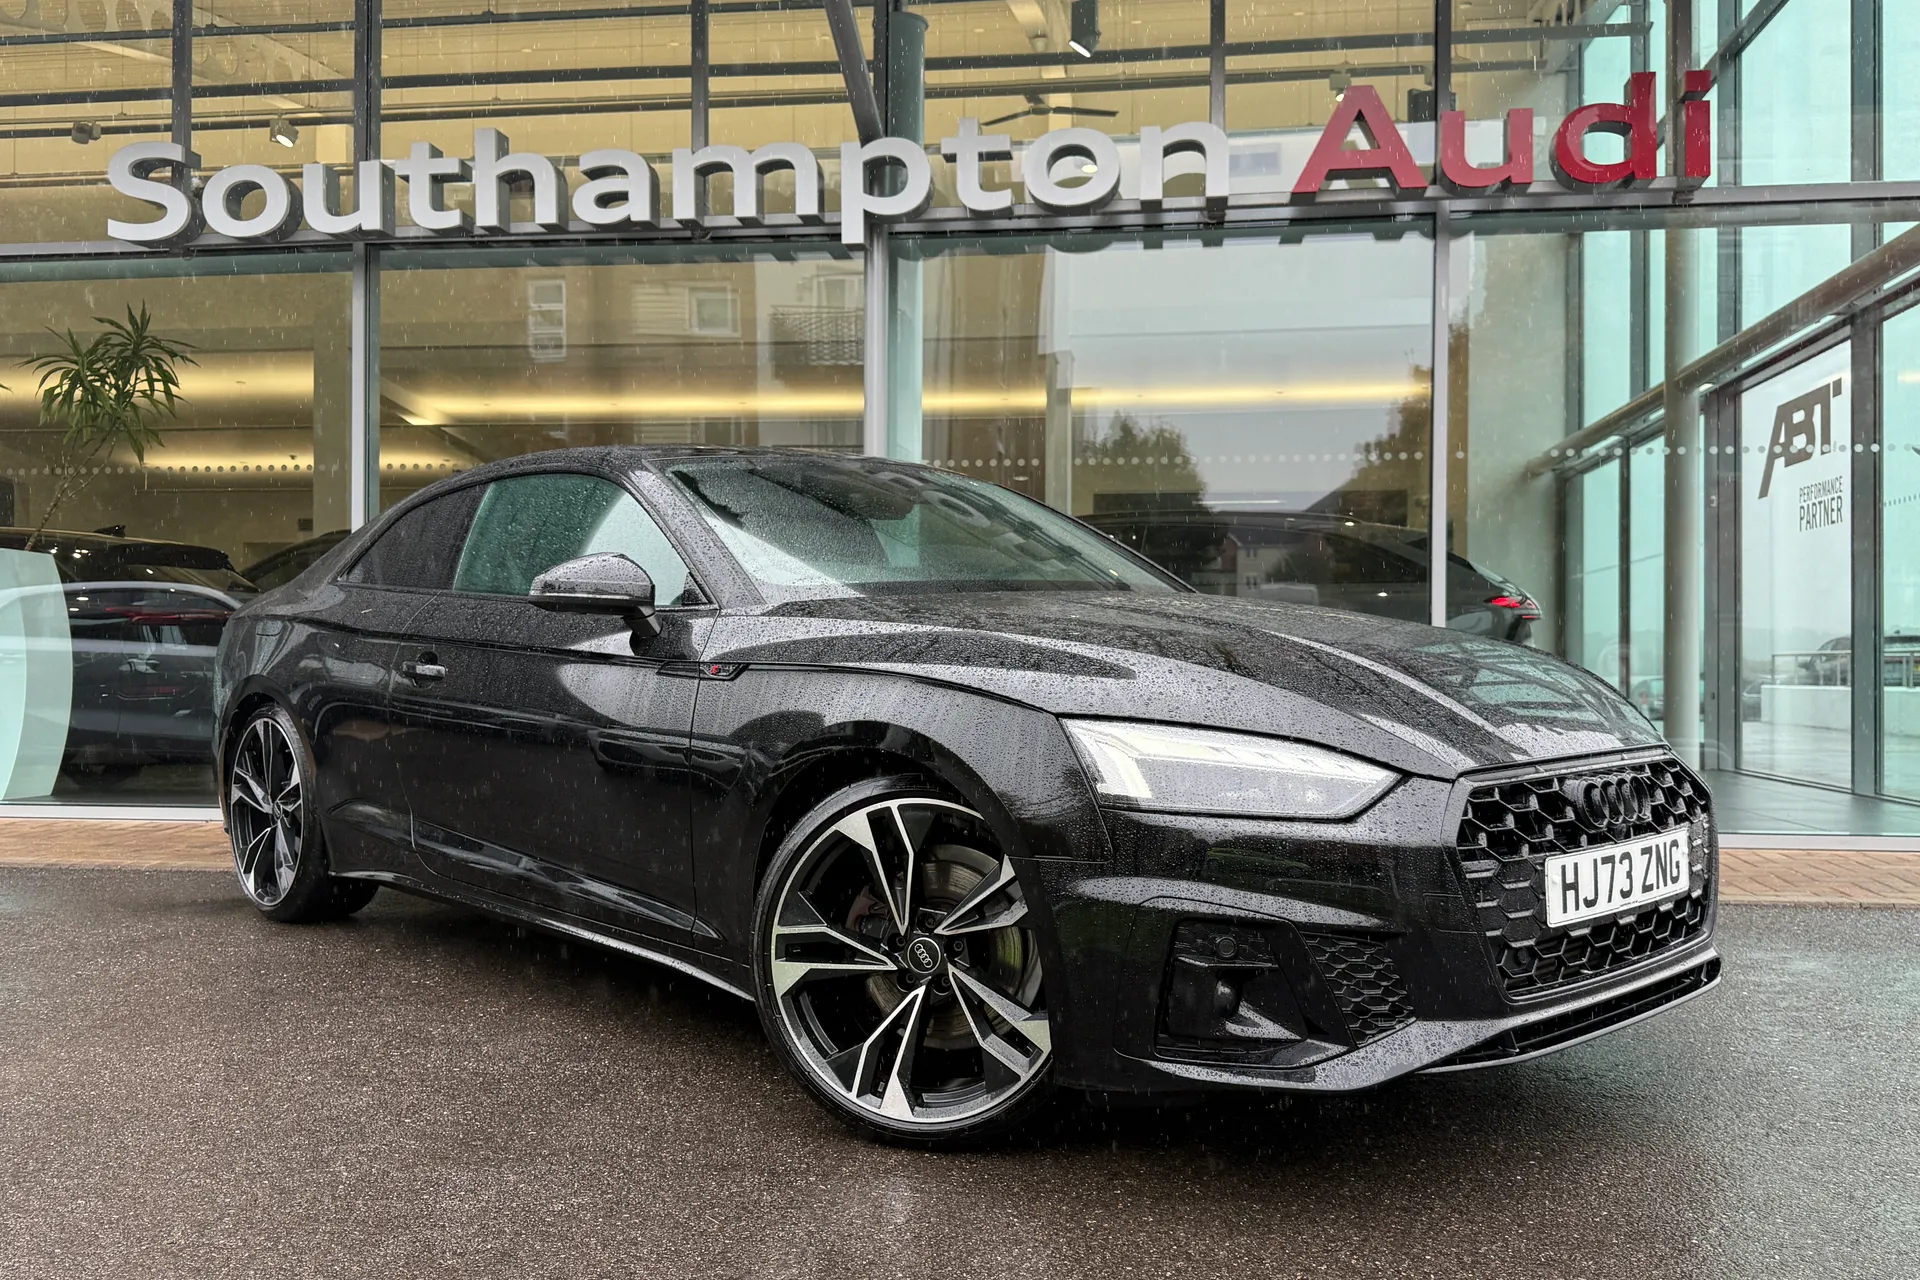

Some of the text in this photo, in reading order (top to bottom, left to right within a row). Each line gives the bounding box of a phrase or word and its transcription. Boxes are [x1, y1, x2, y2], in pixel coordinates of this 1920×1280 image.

[107, 69, 1712, 244] Southampton Audi
[1758, 377, 1843, 500] ABT
[1799, 475, 1843, 504] PERFORMANCE
[1799, 495, 1843, 532] PARTNER
[1560, 838, 1681, 914] HJ73 ZNG
